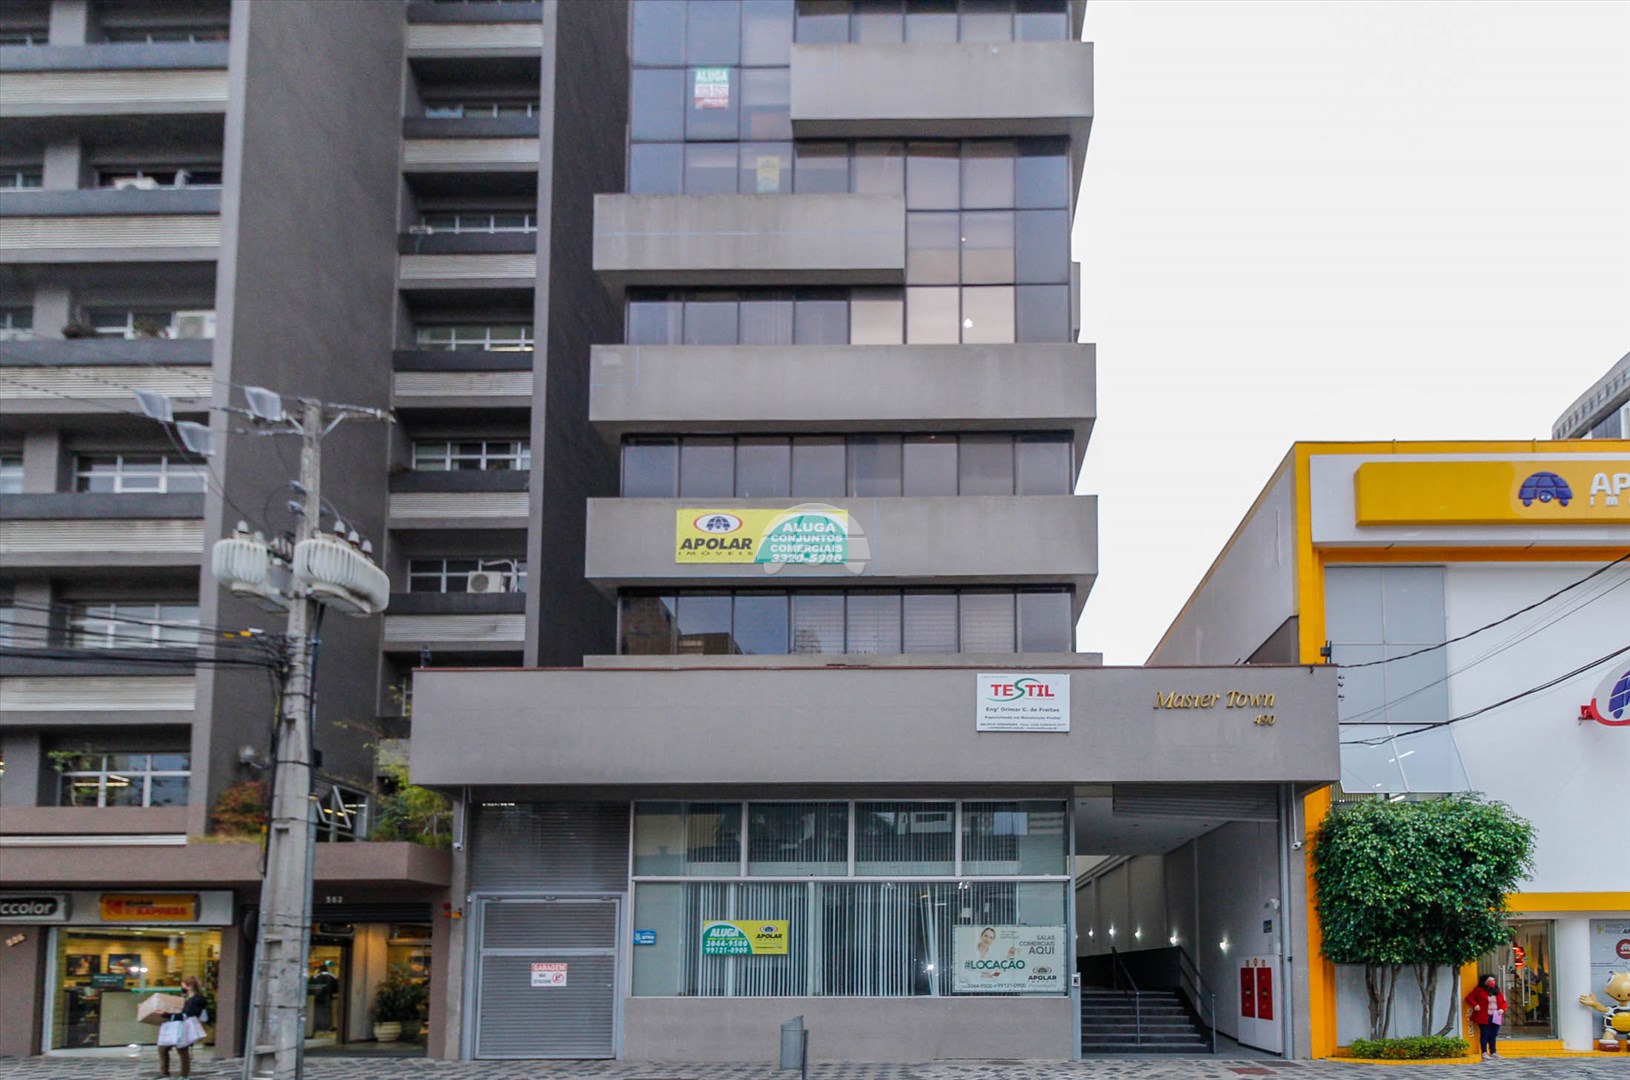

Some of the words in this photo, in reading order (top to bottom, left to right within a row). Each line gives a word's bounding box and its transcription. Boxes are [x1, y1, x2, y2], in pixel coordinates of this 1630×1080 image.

[783, 522, 836, 533] ALUGA
[681, 538, 752, 550] APOLAR
[771, 534, 843, 543] CONJUNTOS
[770, 544, 843, 553] COMERCIAIS
[991, 678, 1055, 698] TESTIL
[1154, 691, 1219, 709] Master
[1226, 690, 1275, 709] Town
[709, 928, 739, 937] ALUGA
[1028, 947, 1055, 955] AQUI
[964, 958, 1026, 972] #LOCAÇÃO
